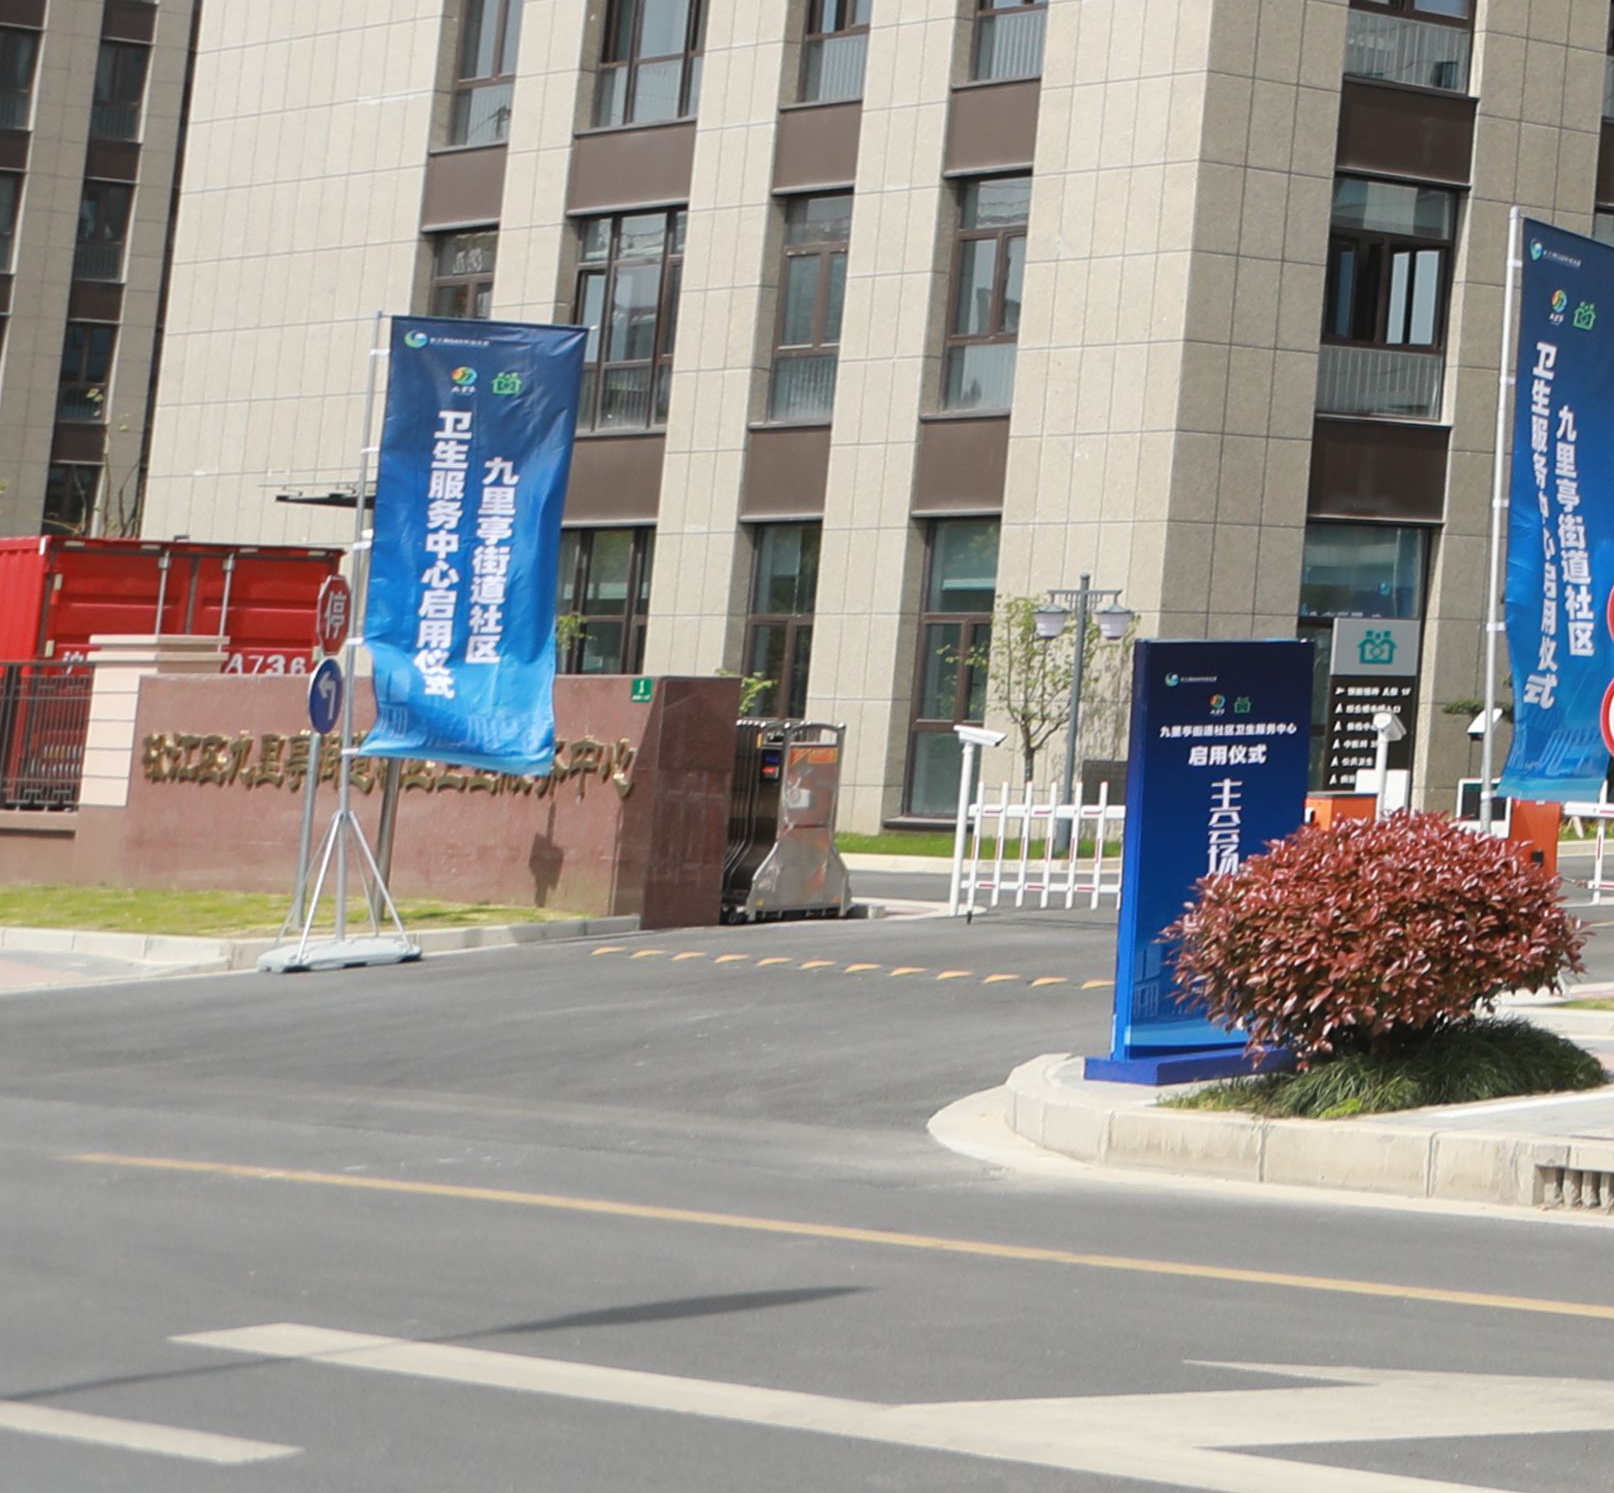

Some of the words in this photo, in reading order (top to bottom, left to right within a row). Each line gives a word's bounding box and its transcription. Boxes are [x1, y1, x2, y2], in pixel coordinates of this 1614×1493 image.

[413, 410, 473, 699] 卫生服务中心启用仪式
[464, 456, 519, 665] 九里亭街道社区
[1554, 404, 1595, 657] 九里亭街道社区
[324, 591, 347, 639] 停
[1188, 744, 1268, 767] 启用仪式
[1207, 778, 1244, 878] 主会场
